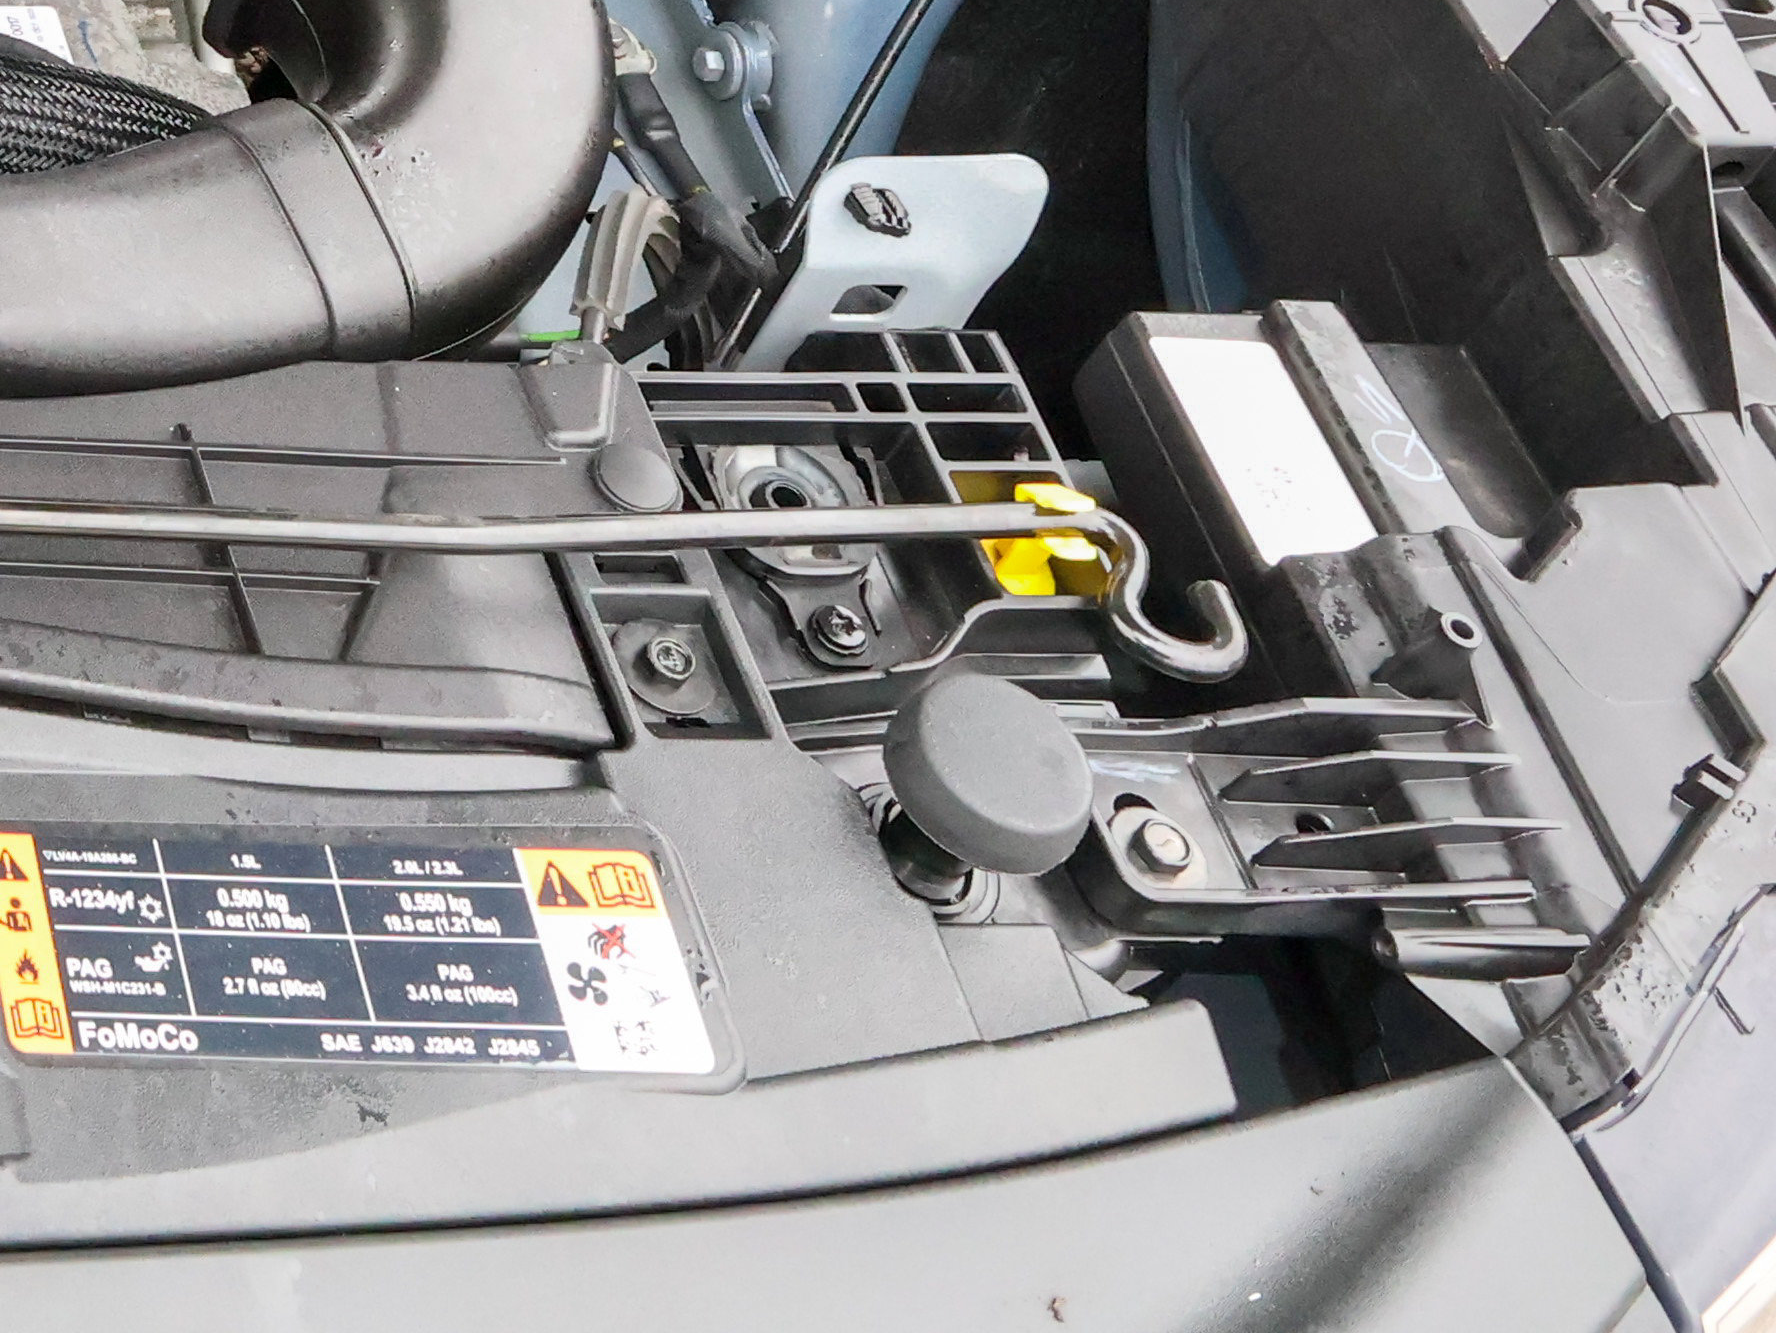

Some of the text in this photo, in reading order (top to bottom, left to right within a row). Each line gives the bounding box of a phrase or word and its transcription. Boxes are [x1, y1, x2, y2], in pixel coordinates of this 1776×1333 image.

[229, 853, 262, 870] 1.5L
[392, 859, 425, 876] 2.0L
[432, 860, 464, 876] 2.3L
[48, 887, 135, 914] R-1234yf
[217, 887, 290, 914] 0.500 kg
[399, 891, 474, 918] 0.550 kg
[206, 910, 225, 927] 18
[226, 913, 245, 928] oz
[384, 914, 415, 933] 19.5
[415, 918, 435, 933] oz
[65, 957, 114, 980] PAG
[250, 957, 287, 977] PAG
[436, 963, 475, 983] PAG
[222, 977, 245, 996] 2.7
[260, 981, 280, 997] oz
[405, 984, 431, 1002] 3.4
[444, 987, 464, 1004] oz
[77, 1020, 199, 1052] FoMoCo
[320, 1032, 363, 1053] SAE
